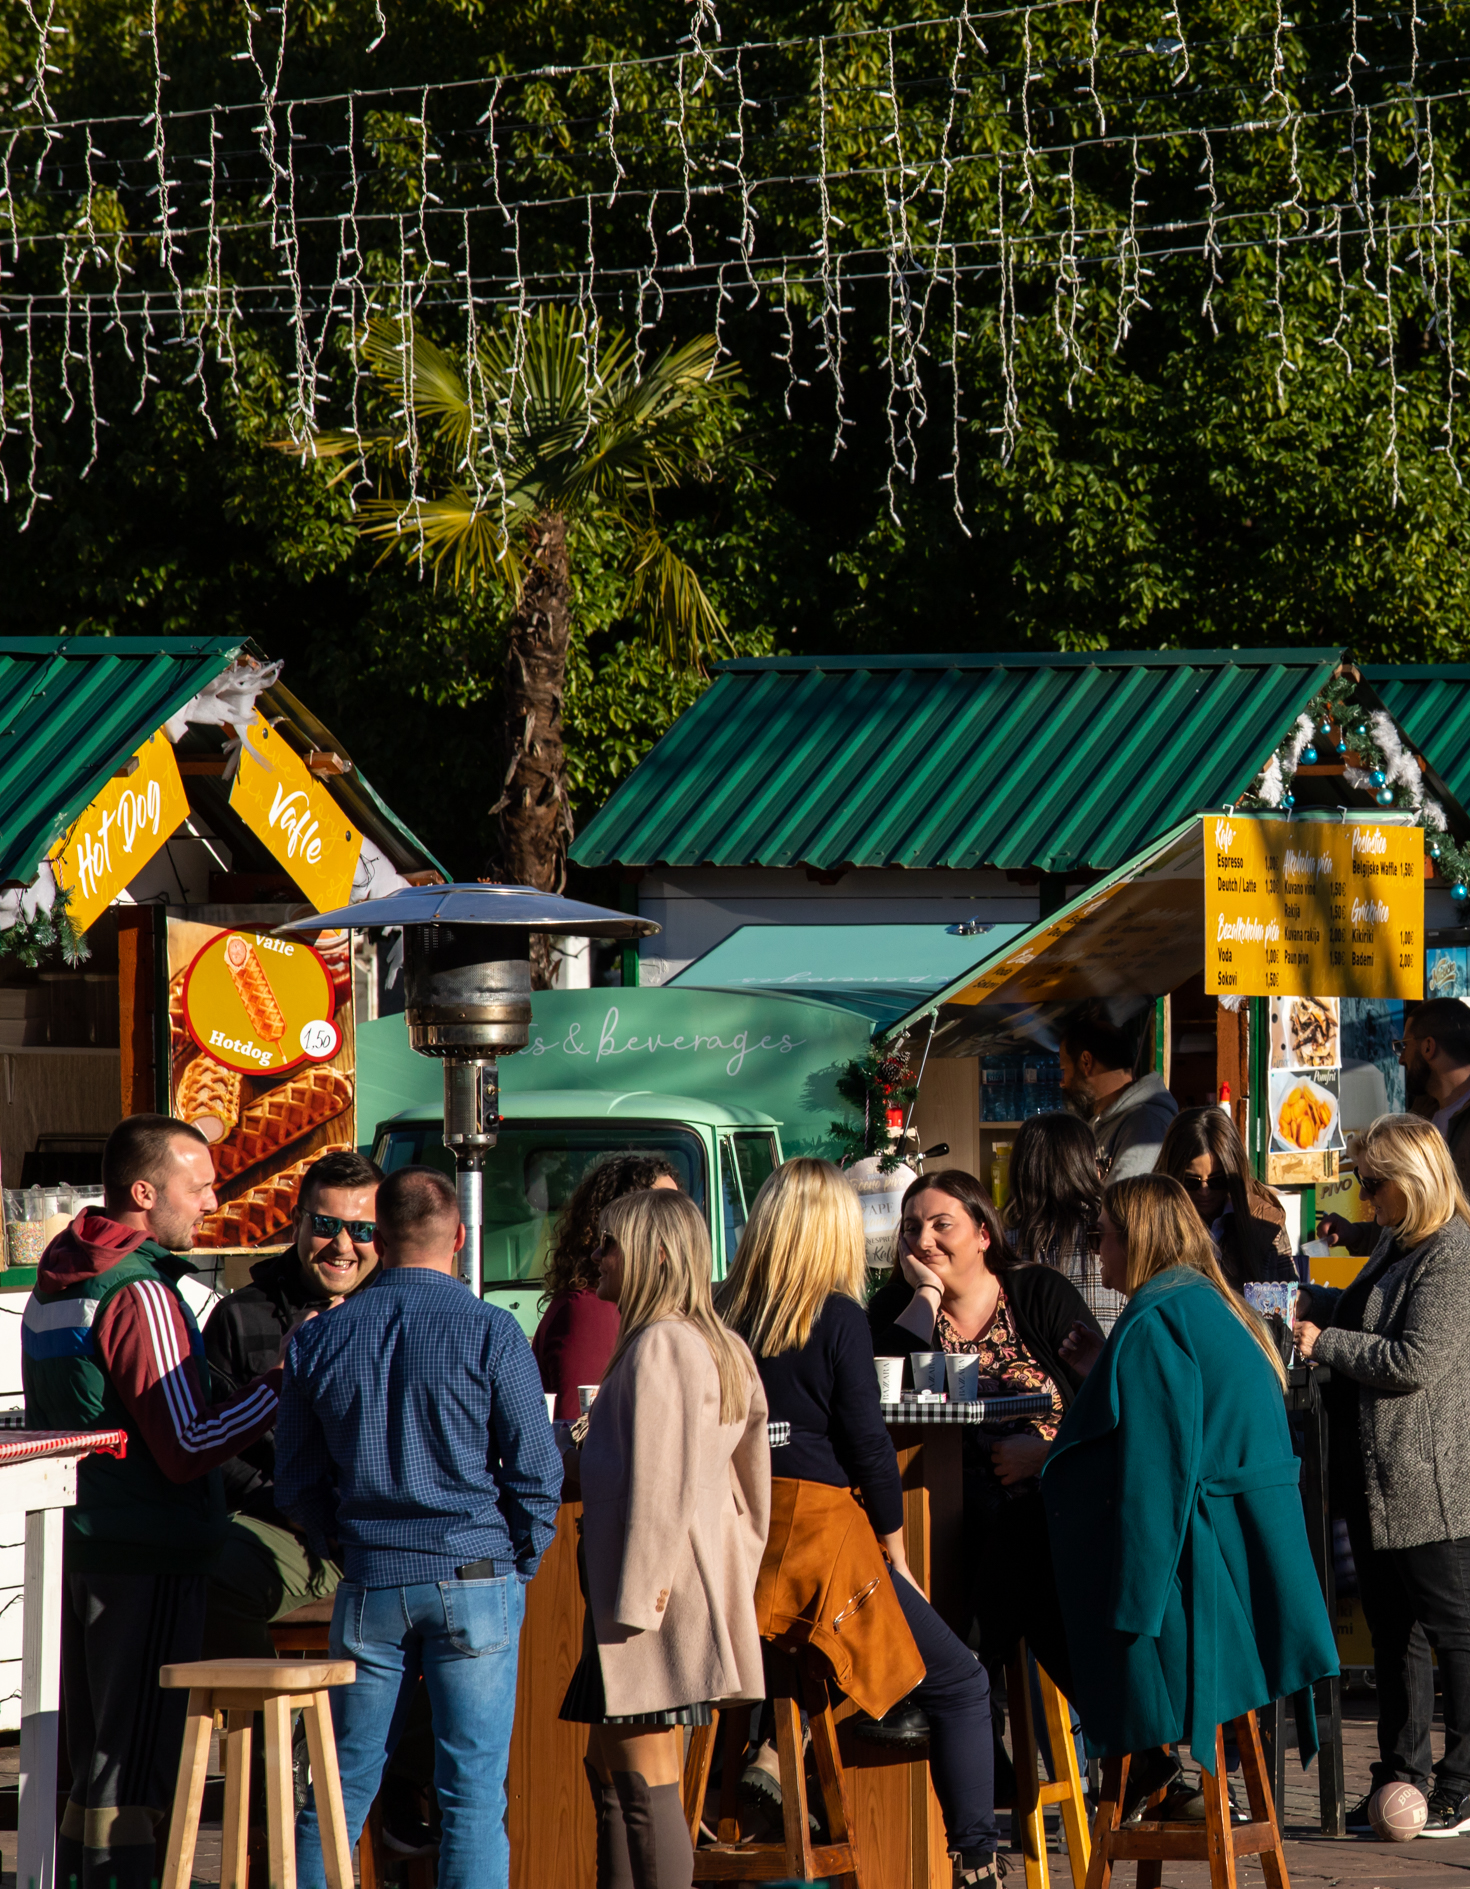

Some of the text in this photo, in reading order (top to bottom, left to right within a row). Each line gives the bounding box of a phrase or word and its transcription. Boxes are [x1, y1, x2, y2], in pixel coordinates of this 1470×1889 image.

[268, 782, 322, 864] Vafle
[77, 780, 161, 899] Hot Dog
[1217, 853, 1243, 871] Espresso
[1353, 860, 1379, 878] Belgijske
[1381, 861, 1398, 876] Waffle
[1217, 877, 1238, 892] Deutch
[1243, 878, 1257, 893] Latte
[1284, 880, 1304, 895] Kuvano
[1305, 881, 1316, 895] vino
[1284, 903, 1301, 920] Rakija
[256, 931, 294, 956] Vafle
[1284, 926, 1303, 942] Kuvana
[1304, 927, 1320, 945] rakija
[1352, 928, 1374, 943] Kikiriki
[1218, 947, 1233, 963] Voda
[1284, 949, 1297, 965] Paun
[1297, 950, 1309, 967] pivo
[1352, 951, 1374, 967] Bademi
[1218, 970, 1238, 986] Sokovi
[208, 1030, 273, 1067] Hotdog
[562, 1022, 591, 1056] &
[595, 1006, 807, 1077] beverages
[1313, 1069, 1337, 1085] Pomfrit
[1321, 1178, 1353, 1199] PIVO
[869, 1202, 895, 1215] APE
[882, 1362, 890, 1400] BAZZARA
